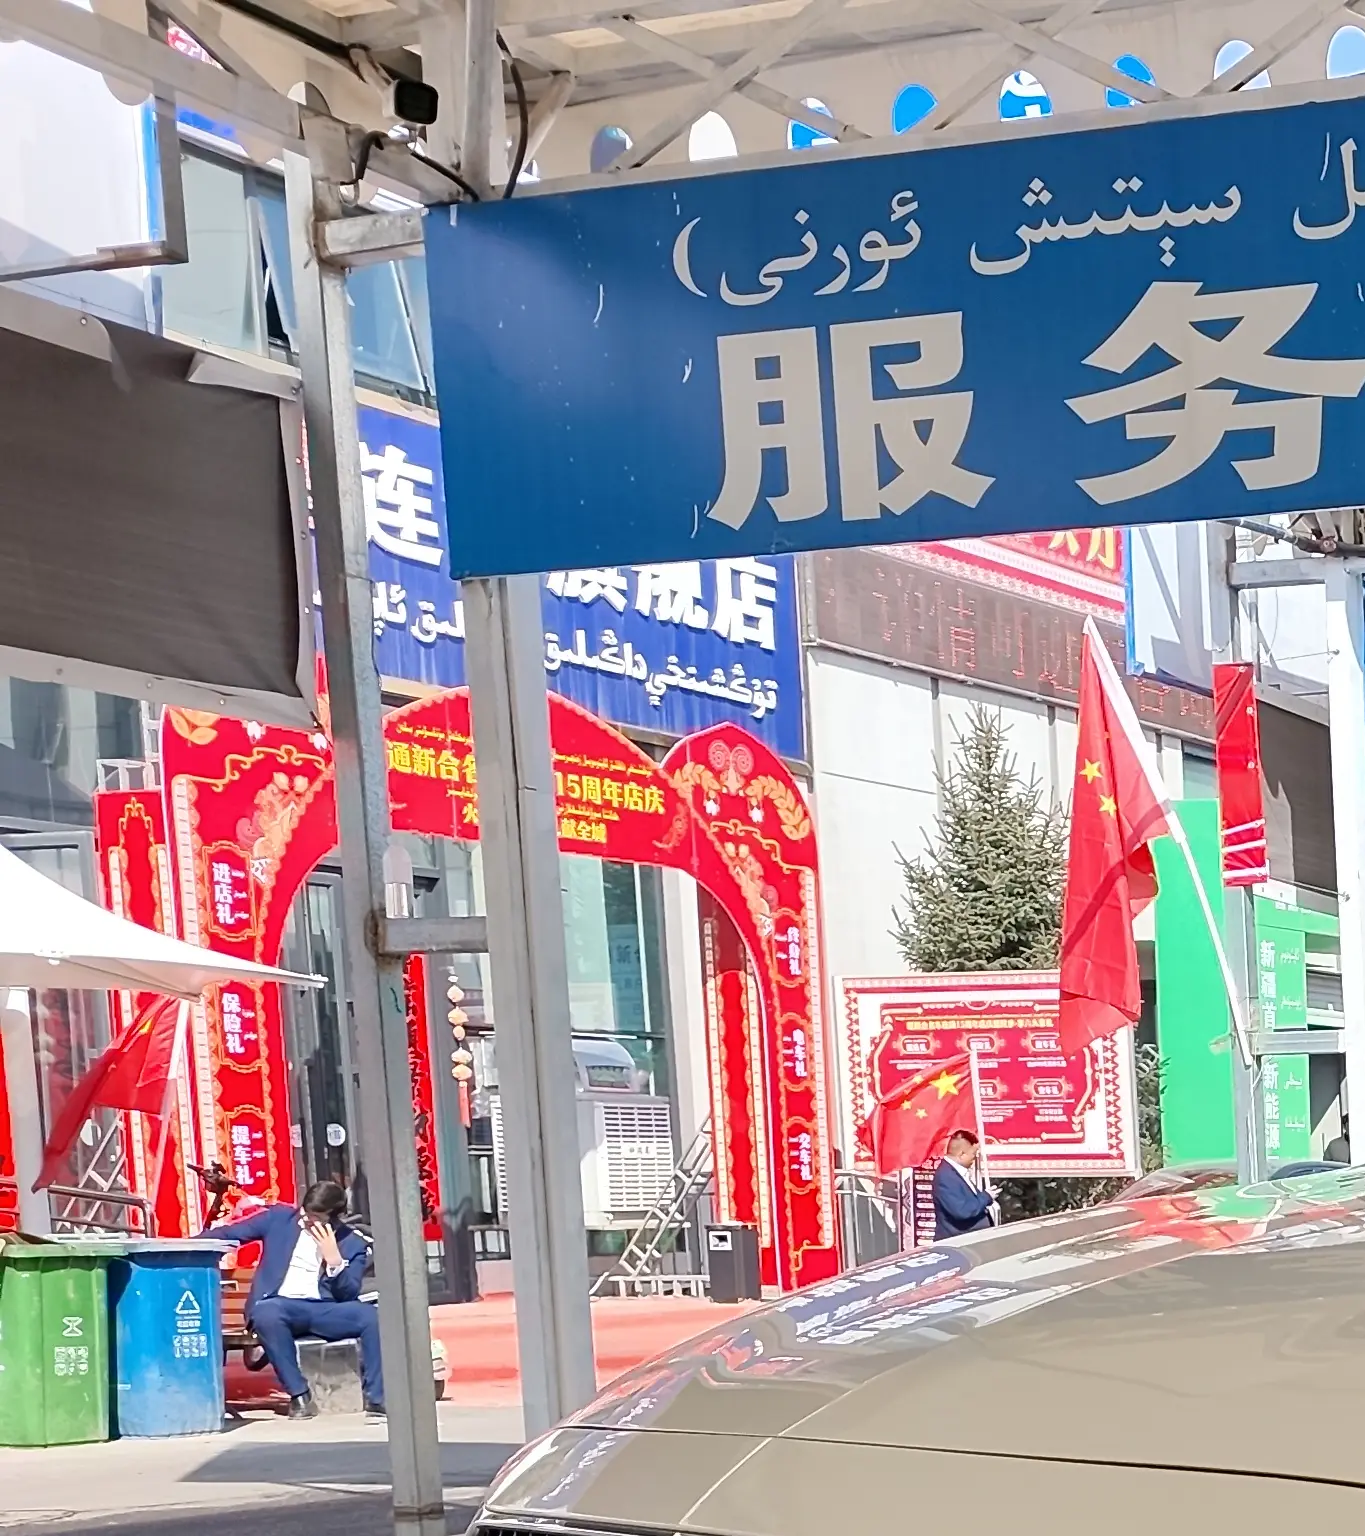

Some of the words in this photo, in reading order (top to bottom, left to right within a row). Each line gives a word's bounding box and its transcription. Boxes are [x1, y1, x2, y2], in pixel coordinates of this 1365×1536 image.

[212, 861, 236, 925] 进店礼
[222, 992, 246, 1055] 保险礼
[231, 1125, 255, 1186] 提车礼
